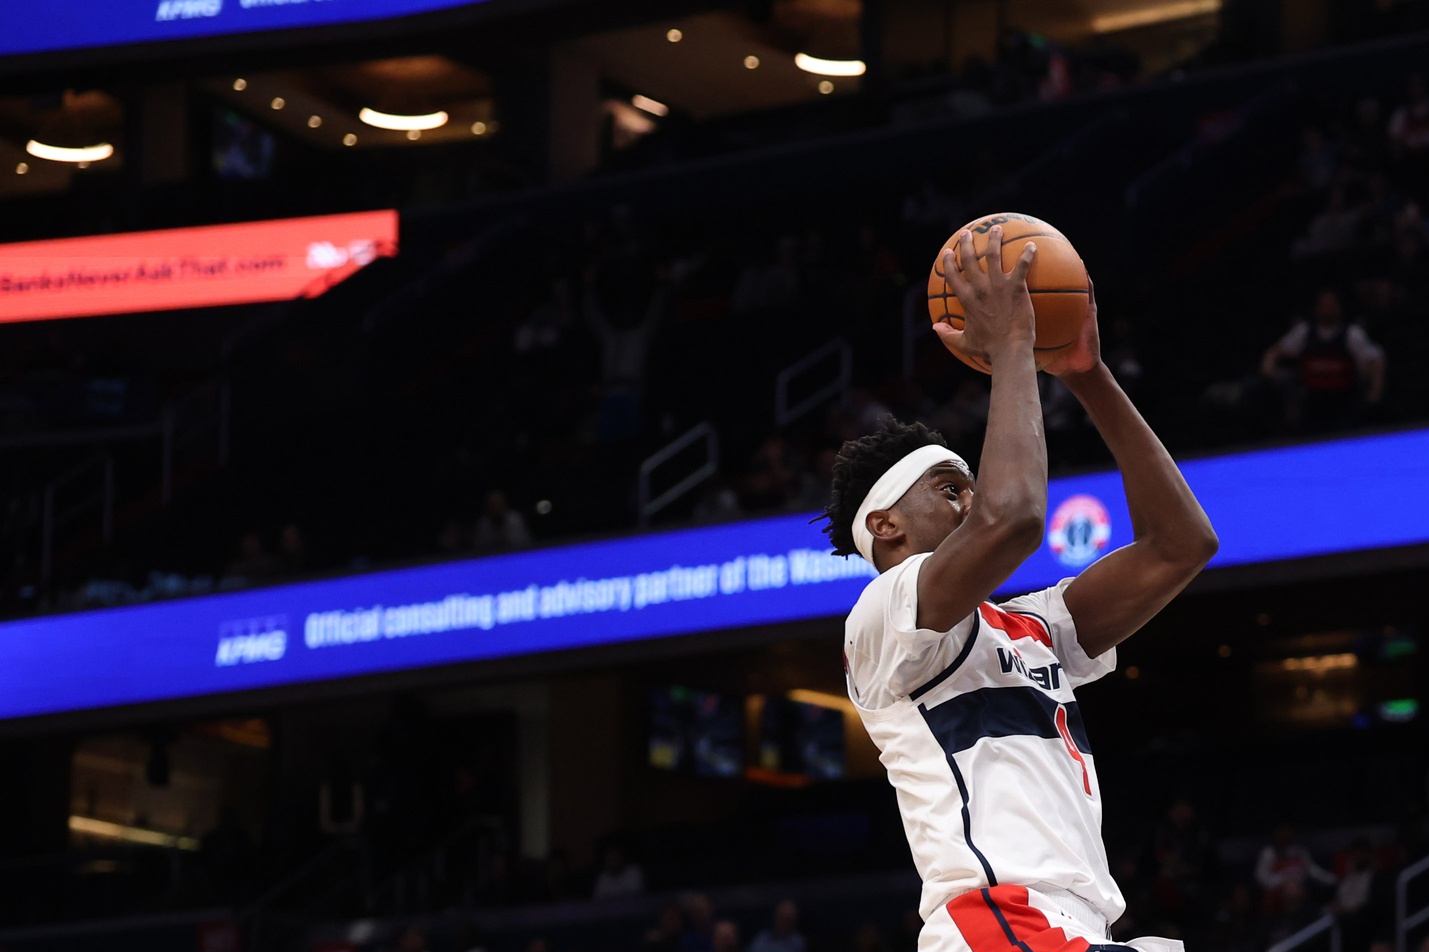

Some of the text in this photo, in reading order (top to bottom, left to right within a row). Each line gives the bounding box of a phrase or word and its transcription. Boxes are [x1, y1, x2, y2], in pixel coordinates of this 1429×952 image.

[305, 604, 381, 649] Official
[383, 593, 494, 639] consulting
[495, 583, 538, 625] and
[539, 576, 632, 619] advisory
[633, 564, 718, 609] partner
[719, 555, 747, 595] of
[747, 552, 788, 591] the
[215, 630, 287, 667] KPMG
